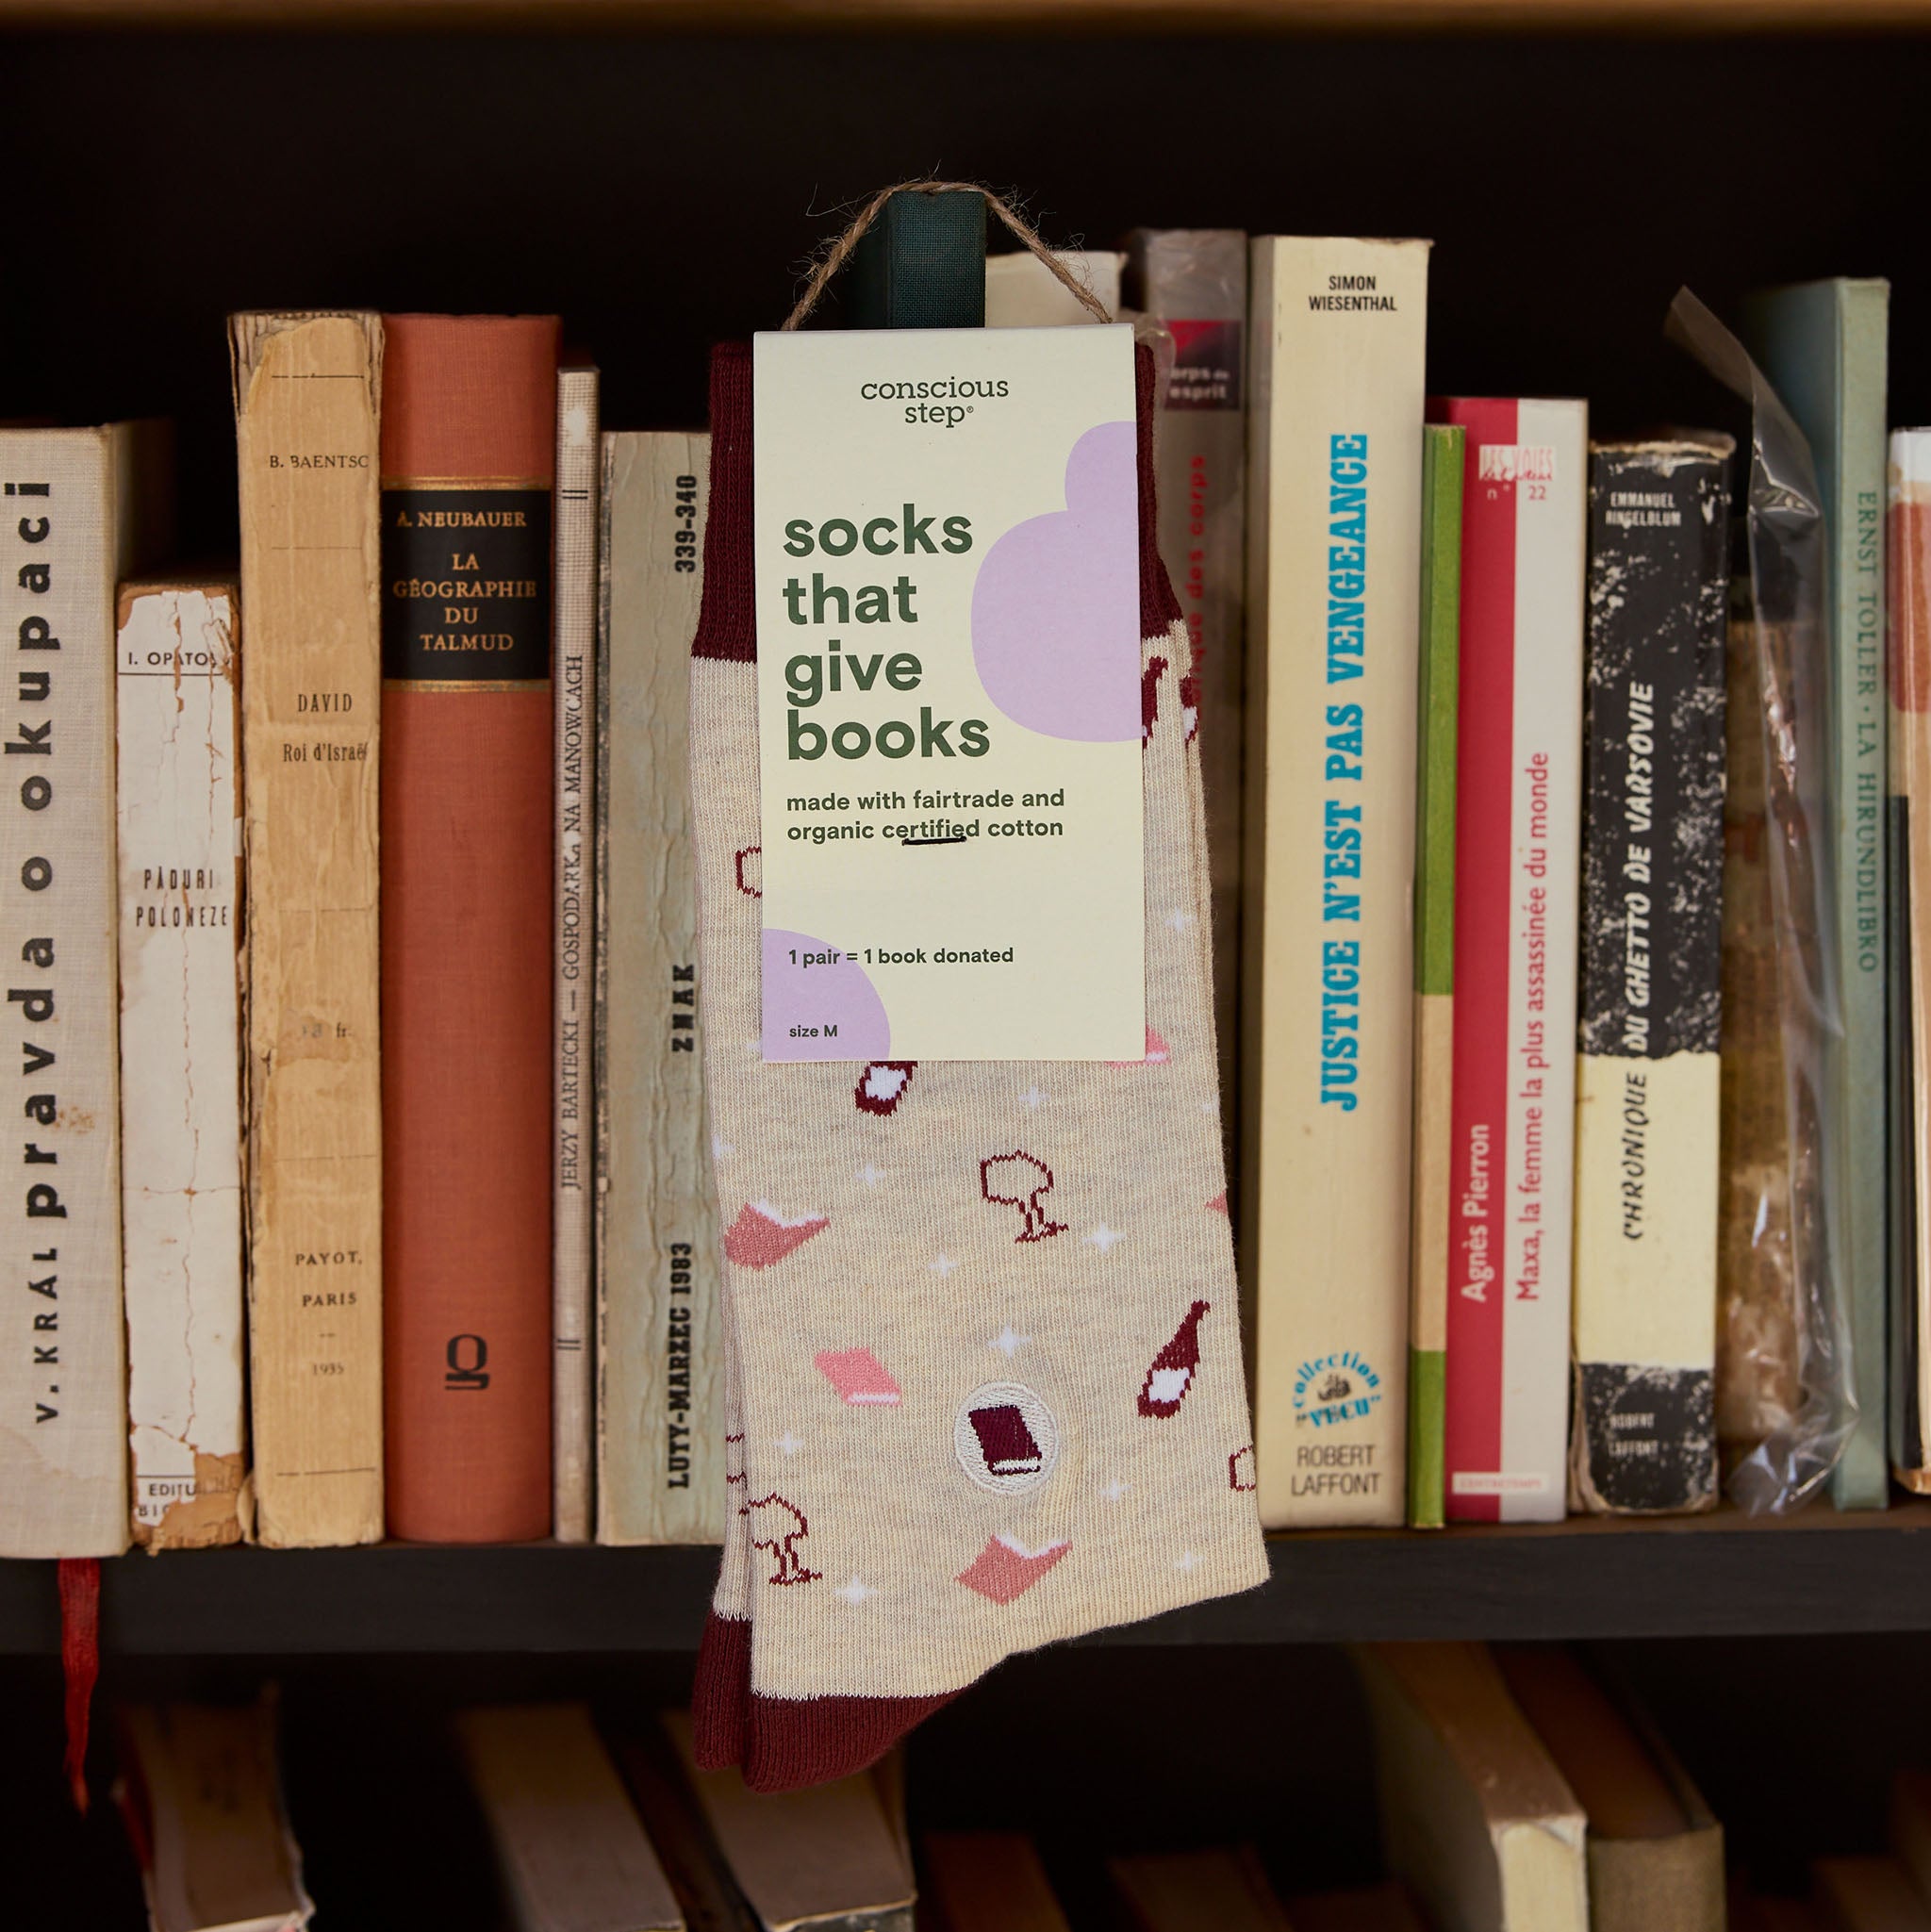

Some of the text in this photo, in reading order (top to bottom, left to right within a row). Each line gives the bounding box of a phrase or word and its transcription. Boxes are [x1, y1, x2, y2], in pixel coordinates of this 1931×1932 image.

[1329, 275, 1377, 290] SIMON
[1309, 295, 1398, 312] WIESENTHAL
[860, 376, 1009, 400] conscious
[270, 455, 285, 469] B.
[1528, 485, 1547, 501] 22
[1610, 491, 1675, 508] EMMANUEL
[417, 511, 528, 527] NEUBAUER
[674, 474, 697, 573] 339-340
[783, 504, 974, 557] socks
[1857, 491, 1877, 576] ERNST
[452, 553, 480, 571] LA
[443, 606, 479, 624] DU
[783, 573, 919, 625] that
[4, 482, 60, 812] okupaci
[128, 652, 139, 666] I.
[420, 633, 515, 652] TALMUD
[1857, 591, 1877, 696] TOLLER
[784, 639, 923, 708] give
[297, 693, 353, 713] DAVID
[564, 654, 584, 795] MANOWCACH
[786, 706, 991, 760] books
[1857, 721, 1877, 758] LA
[283, 743, 307, 763] Roi
[1625, 680, 1655, 834] VARSOVIE
[1320, 433, 1368, 1112] JUSTICE N'EST PAS VENGEANCE
[786, 788, 1065, 811] made with fairtrade and
[564, 803, 582, 833] NA
[787, 818, 1064, 845] organic certified cotton
[21, 856, 54, 892] o
[1623, 843, 1651, 884] DE
[137, 905, 227, 927] POLONEZE
[788, 949, 797, 966] 1
[802, 948, 841, 969] pair
[864, 949, 872, 965] 1
[878, 948, 927, 965] book
[933, 947, 1014, 964] donated
[1623, 892, 1652, 1009] GHETTO
[672, 964, 695, 1053] ZNAK
[1515, 751, 1551, 1301] Maxa, la femme la plus assassinée du monde
[789, 1024, 838, 1038] size M
[1622, 1015, 1648, 1053] DU
[7, 937, 68, 1218] pravda
[562, 1020, 582, 1121] BARTECKI
[560, 1129, 583, 1191] JERZY
[1460, 1123, 1495, 1302] Agnès Pierron
[28, 1247, 58, 1364] KRÁL
[302, 1292, 357, 1307] PARIS
[668, 1242, 693, 1489] LUTY-MARZEC 1983
[1296, 1444, 1376, 1467] ROBERT
[1290, 1472, 1381, 1496] LAFFONT
